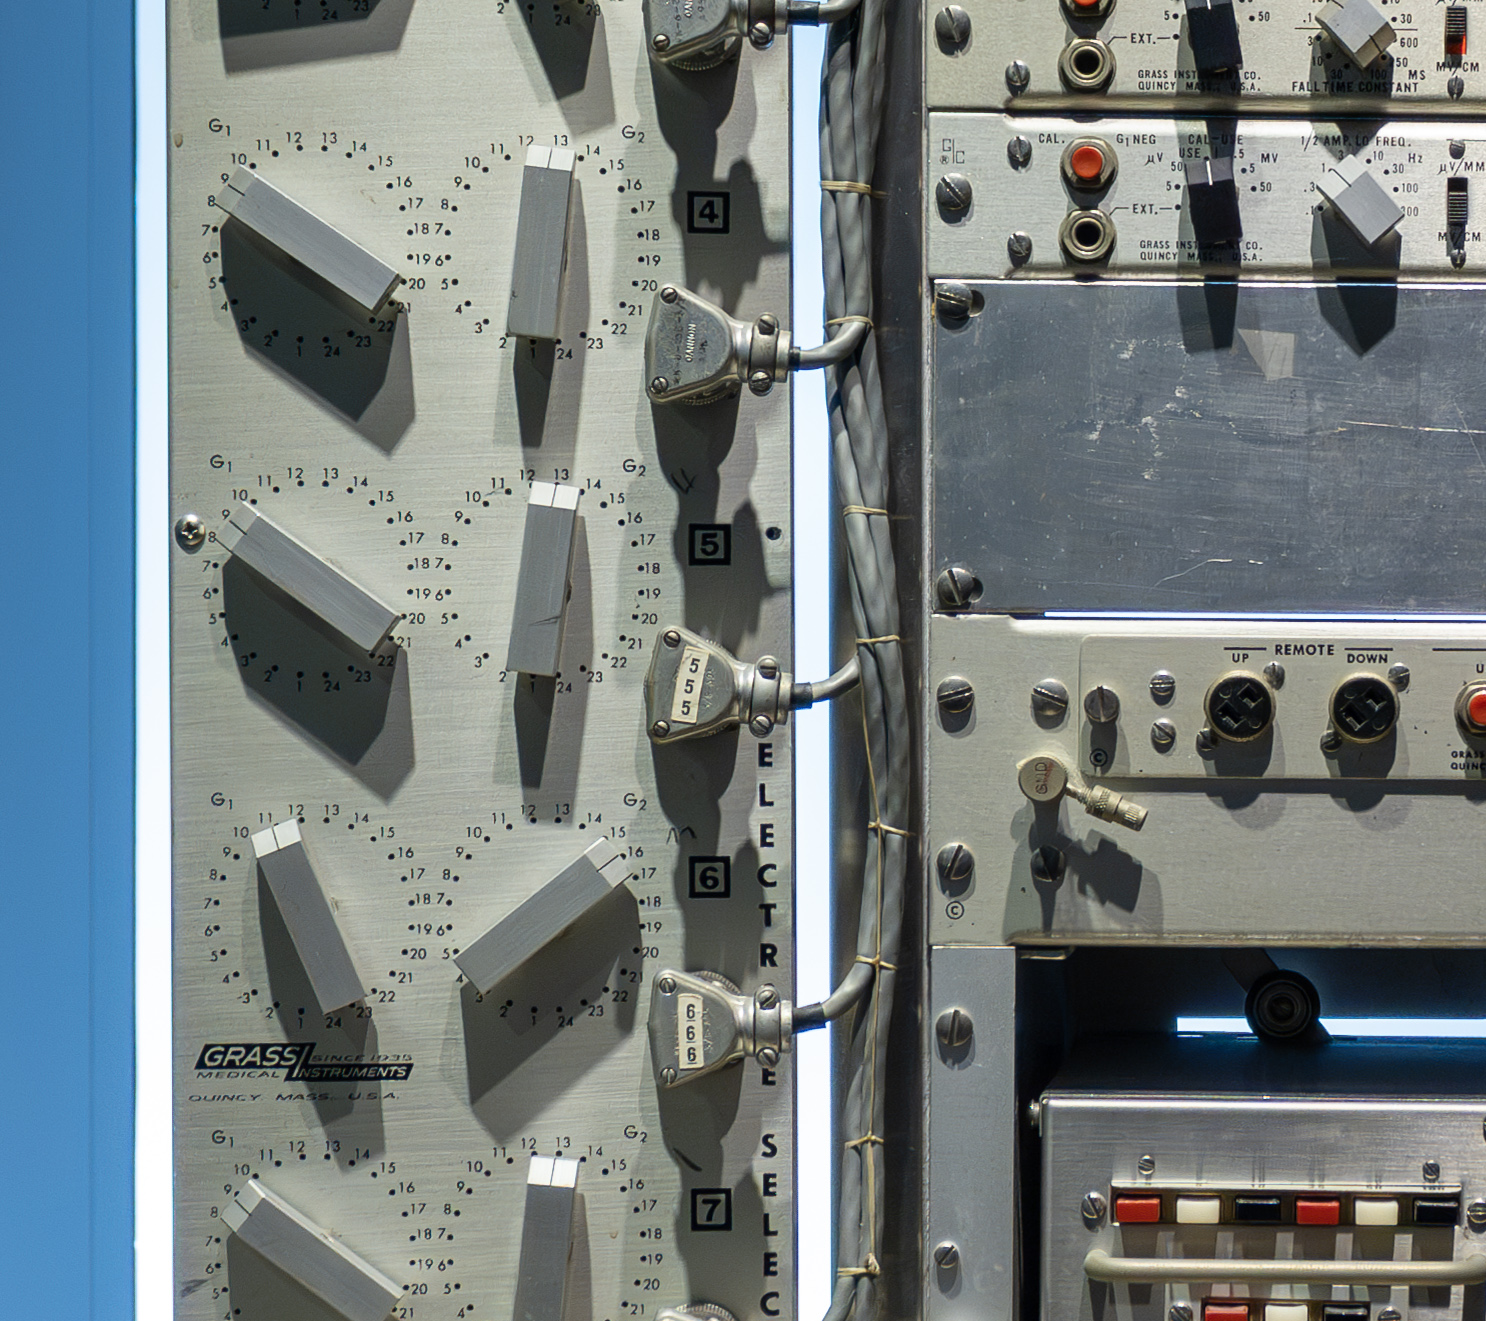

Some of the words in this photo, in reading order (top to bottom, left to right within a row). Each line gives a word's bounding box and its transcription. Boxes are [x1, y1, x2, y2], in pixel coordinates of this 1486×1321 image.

[1274, 643, 1336, 657] REMOTE
[1230, 652, 1251, 665] UP
[1345, 653, 1390, 666] DOWN
[1449, 749, 1486, 761] GRASS
[755, 741, 781, 1086] ELECTRE
[201, 1044, 298, 1068] GRASS
[195, 1069, 281, 1081] MEDICAL
